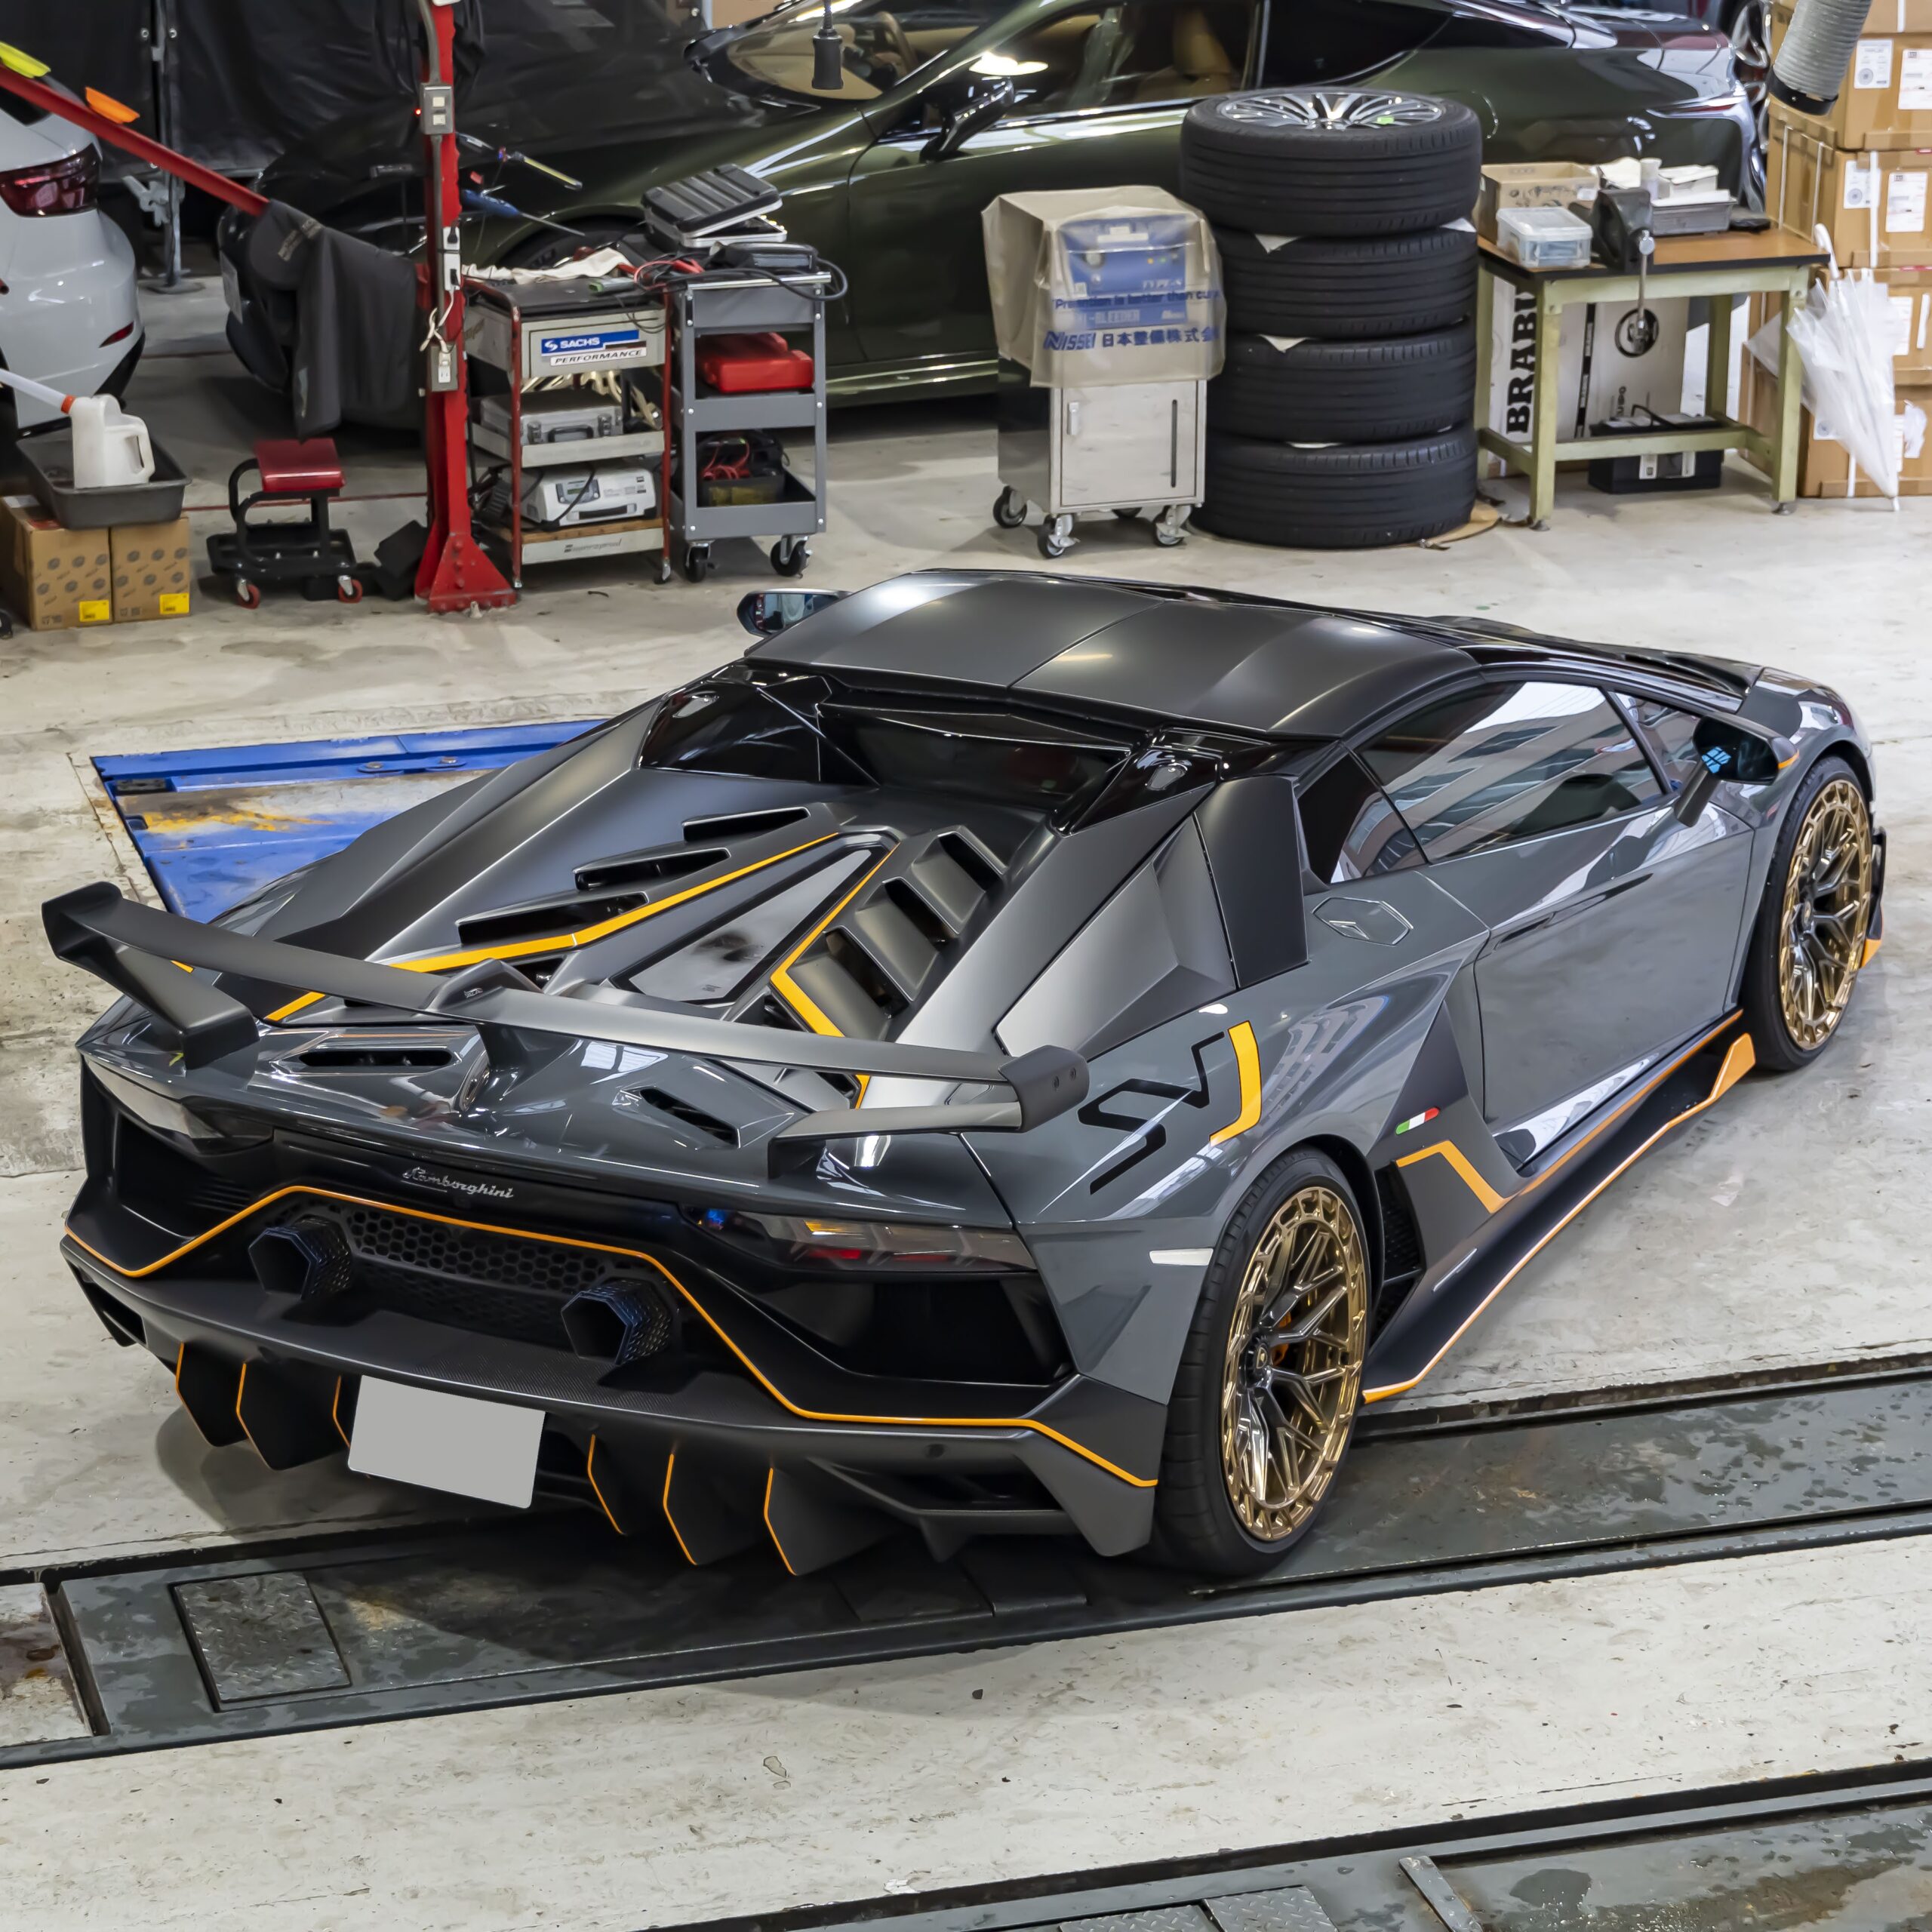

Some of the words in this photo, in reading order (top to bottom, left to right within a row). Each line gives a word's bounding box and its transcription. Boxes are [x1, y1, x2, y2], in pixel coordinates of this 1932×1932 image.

[559, 337, 601, 349] SACHS
[555, 350, 641, 364] PERFORMANCE
[1506, 286, 1537, 433] BRABU
[401, 1166, 515, 1198] Lamborghini
